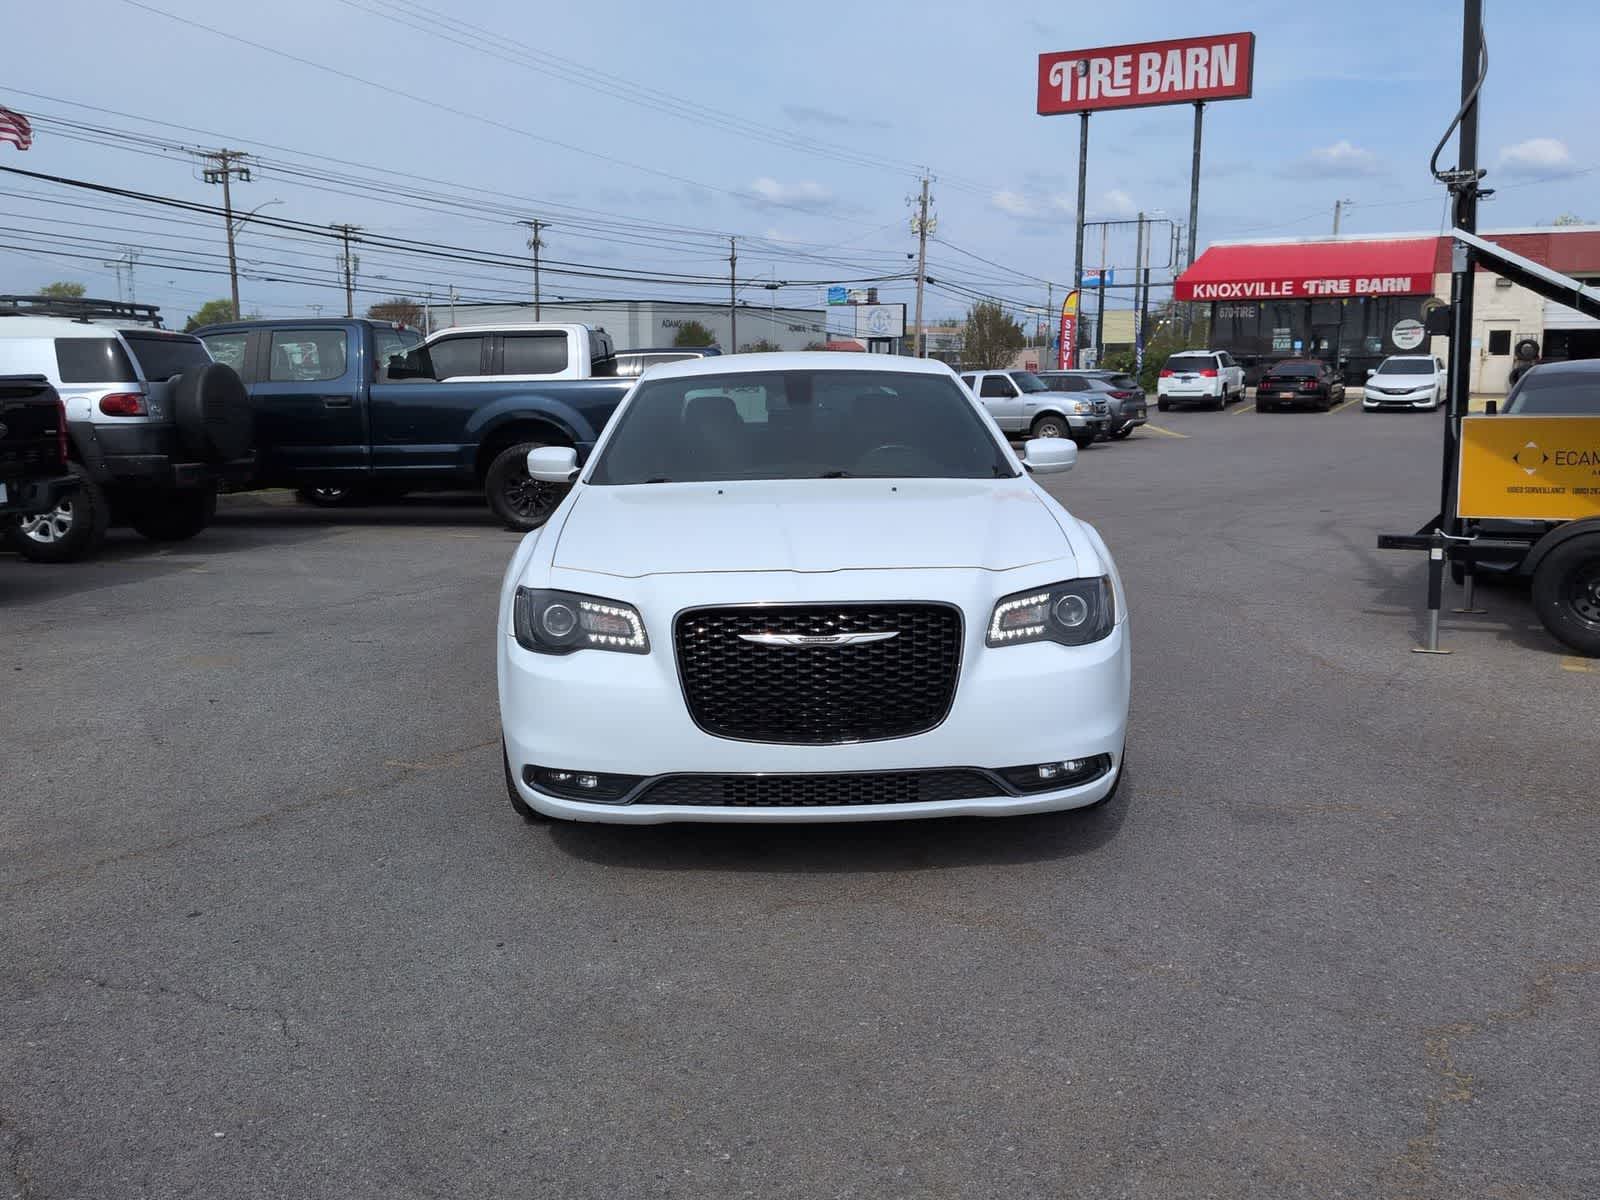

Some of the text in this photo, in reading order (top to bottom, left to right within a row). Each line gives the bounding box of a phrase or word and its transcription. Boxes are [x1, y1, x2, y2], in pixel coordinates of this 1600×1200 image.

[1138, 43, 1238, 95] BARN
[1193, 281, 1293, 298] KNOXVILLE
[1355, 277, 1411, 292] BARN
